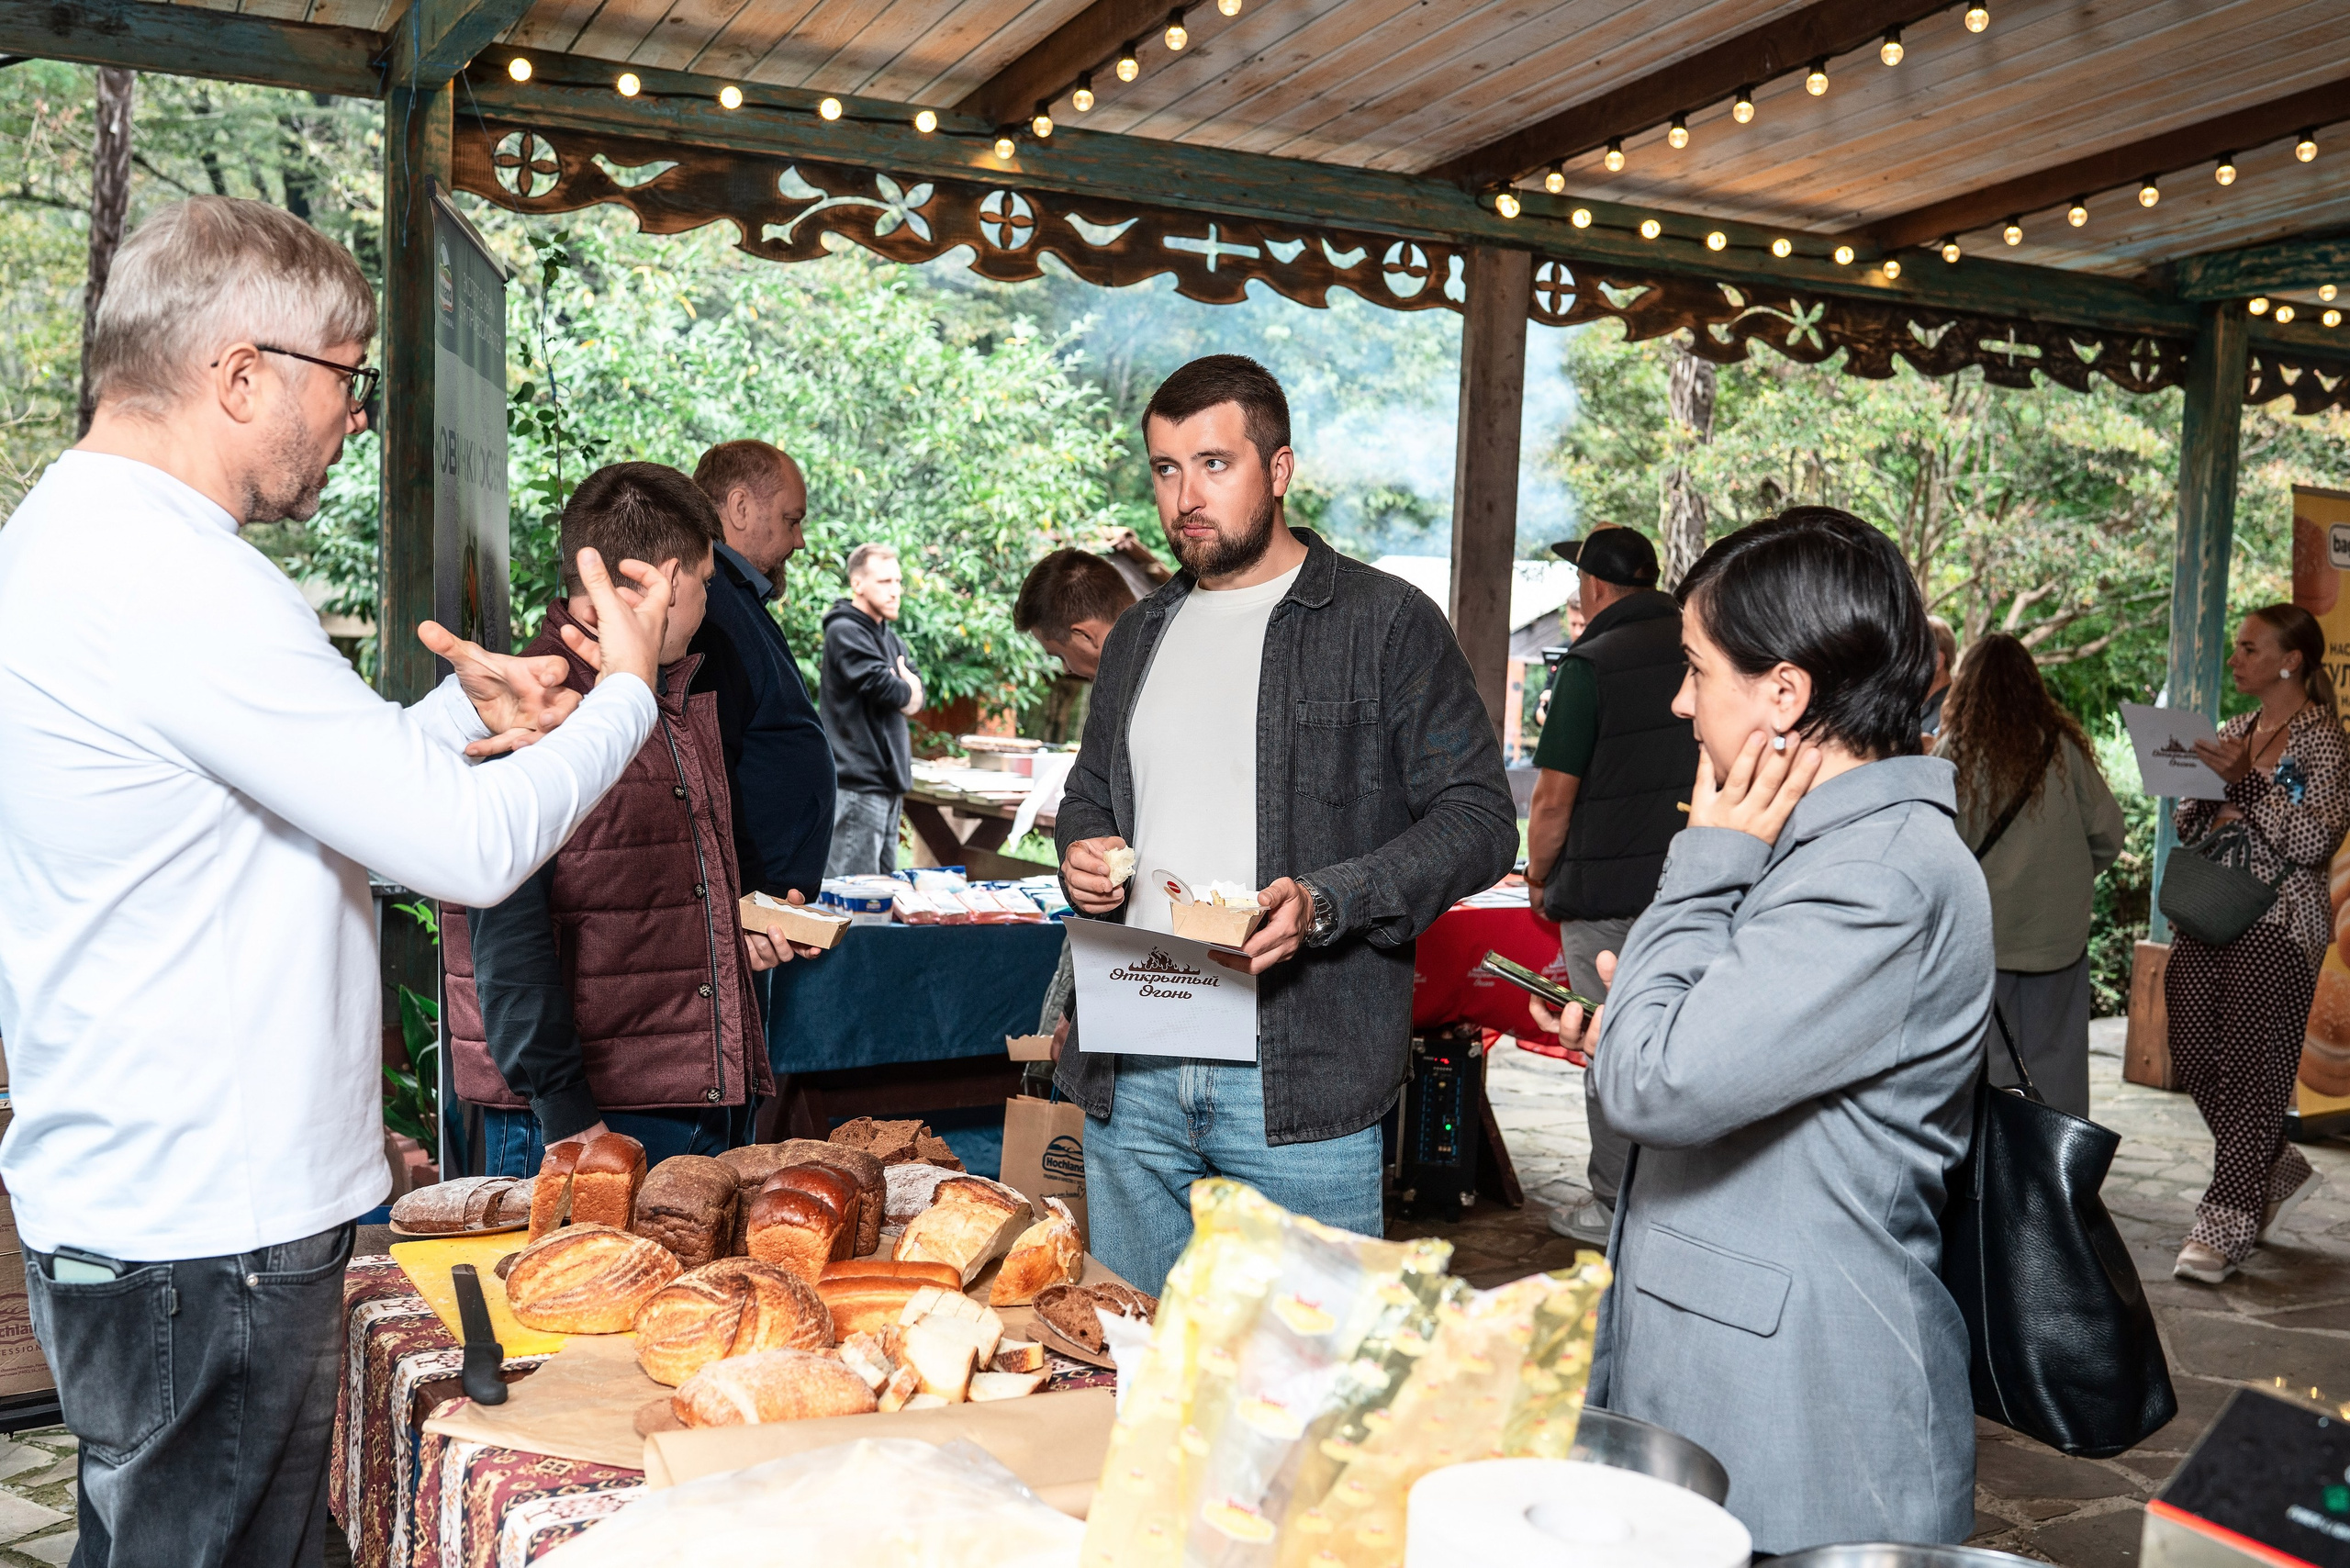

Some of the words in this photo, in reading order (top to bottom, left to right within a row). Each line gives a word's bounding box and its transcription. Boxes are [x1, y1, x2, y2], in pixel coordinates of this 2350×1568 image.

[2333, 532, 2350, 558] ba
[1109, 968, 1220, 987] Открытый
[1139, 984, 1192, 999] Огонь
[1046, 1157, 1084, 1173] Hochland
[2, 1345, 42, 1356] ESSION
